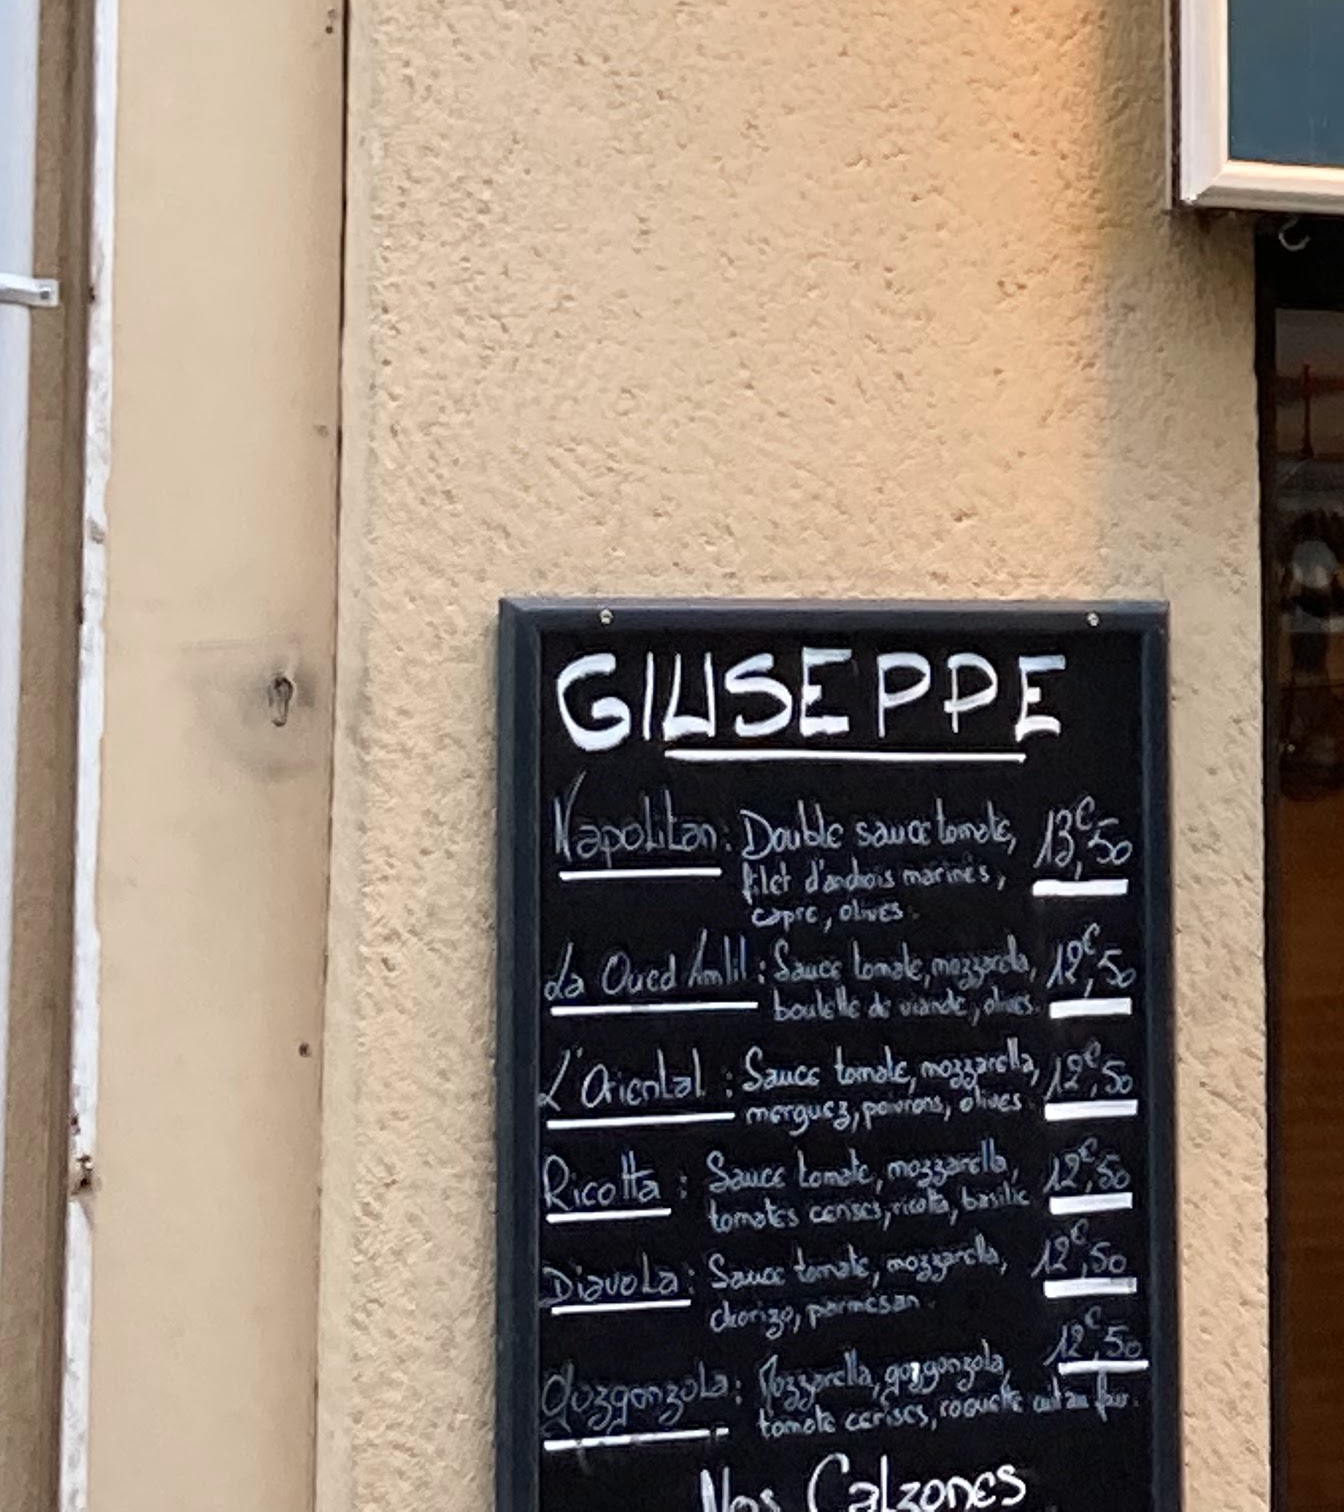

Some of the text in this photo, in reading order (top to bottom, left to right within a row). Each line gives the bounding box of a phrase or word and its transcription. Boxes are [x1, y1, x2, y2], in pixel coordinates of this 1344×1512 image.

[557, 646, 1067, 752] GIUSEPPE
[740, 800, 844, 860] Double
[773, 938, 842, 982] Sauce
[867, 989, 892, 1019] de
[742, 1046, 821, 1093] Sauce
[705, 1149, 787, 1193] Sauce
[708, 1252, 787, 1289] Sauce
[807, 1452, 1027, 1512] Calzones
